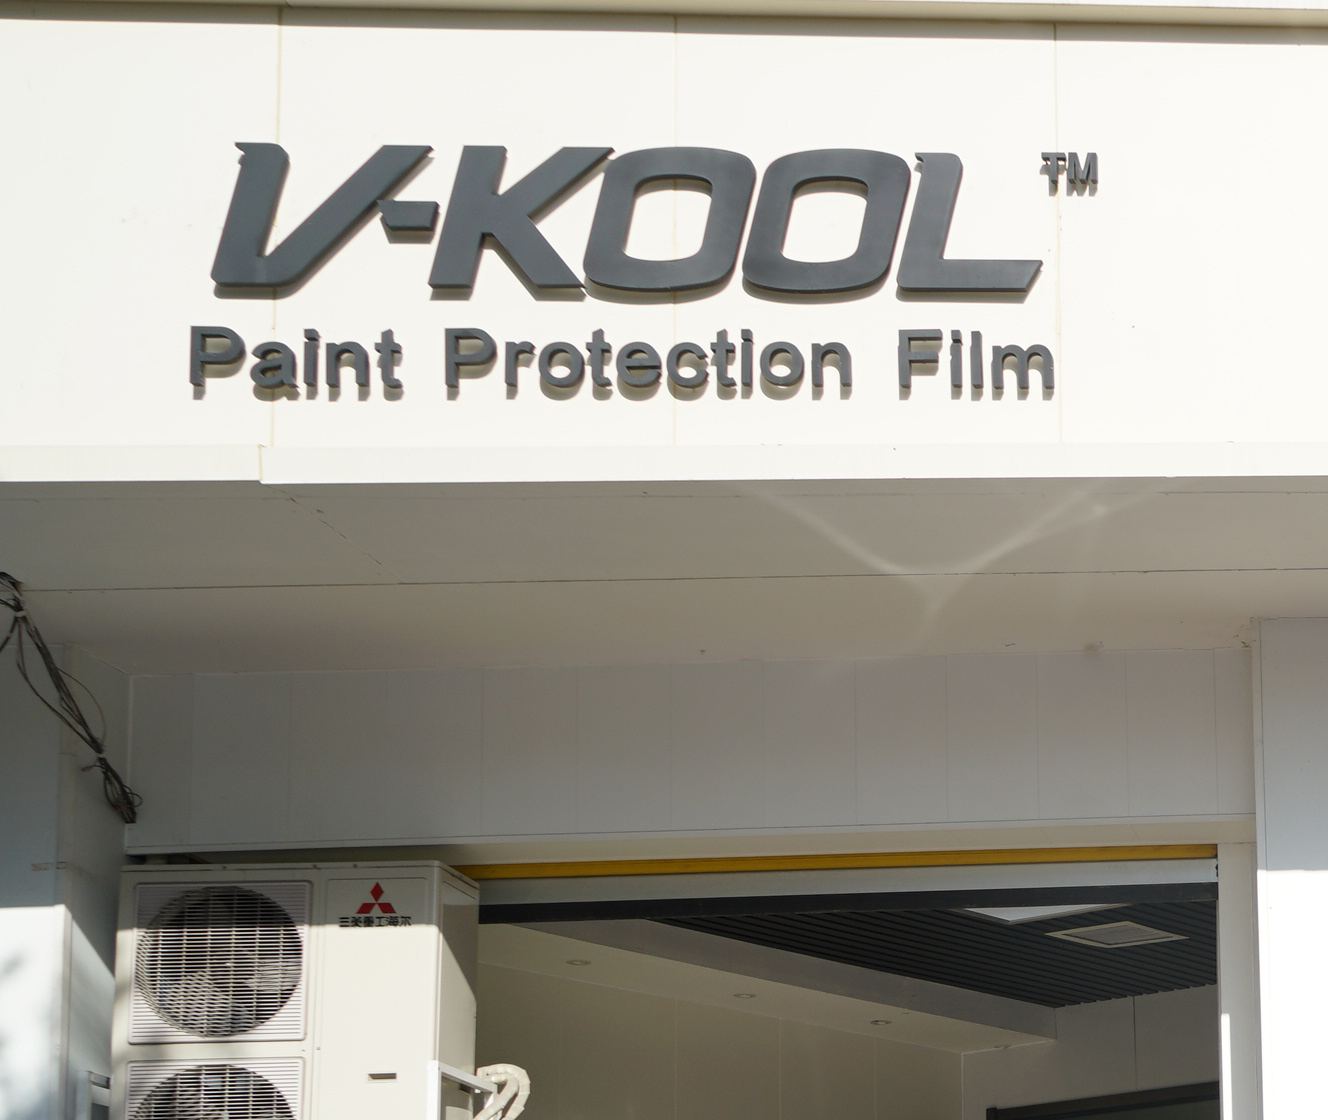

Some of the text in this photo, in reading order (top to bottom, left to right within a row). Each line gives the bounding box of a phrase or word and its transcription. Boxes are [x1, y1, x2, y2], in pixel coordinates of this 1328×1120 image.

[210, 142, 1043, 297] V-KOOL
[190, 325, 1054, 396] Paint Protection Film
